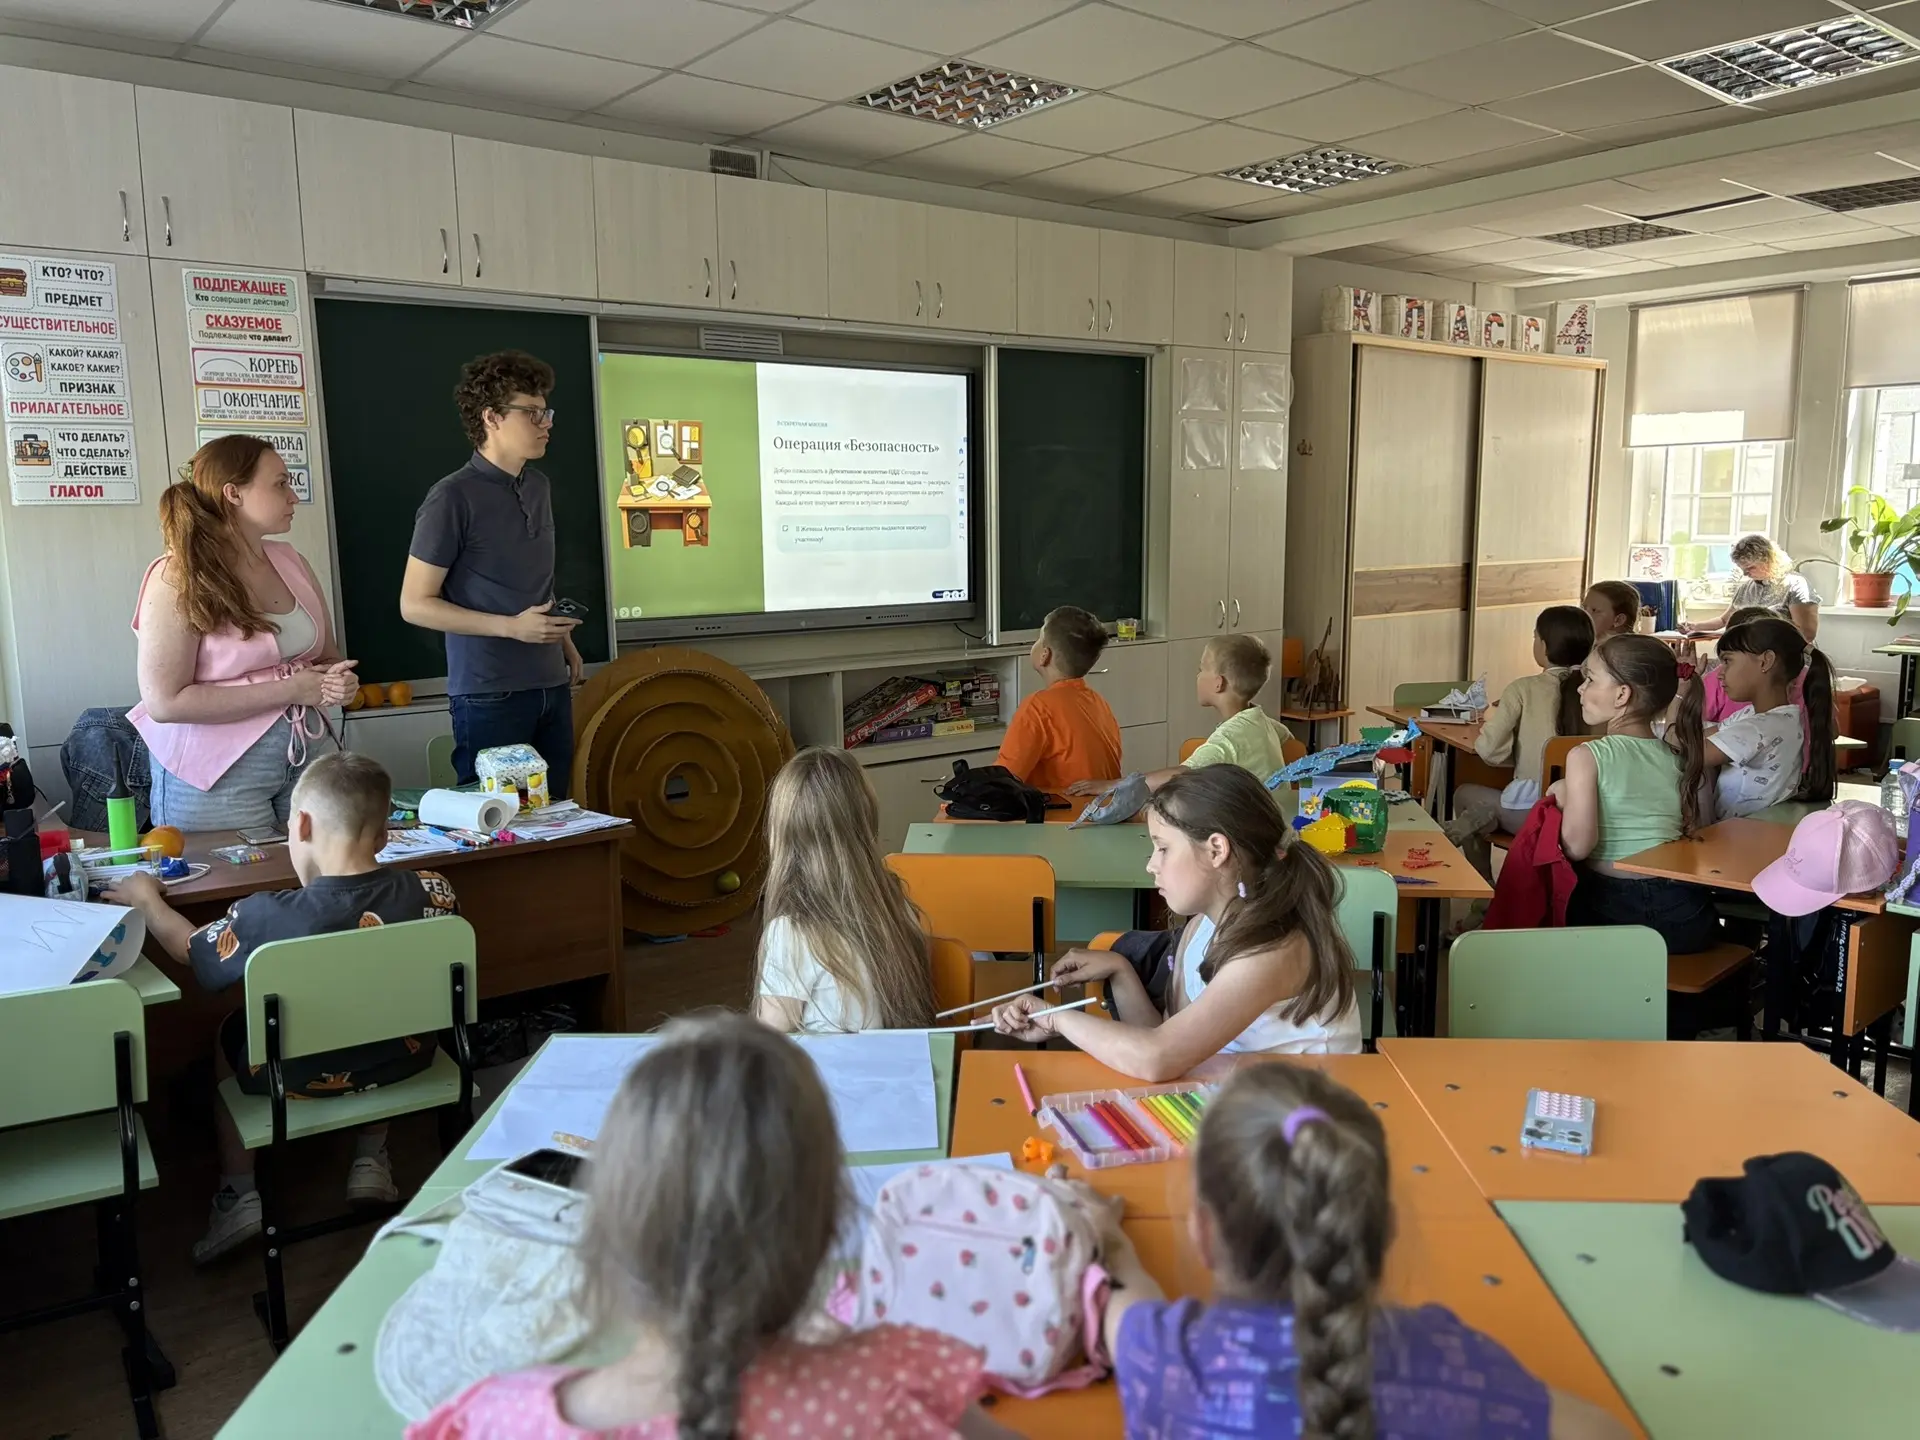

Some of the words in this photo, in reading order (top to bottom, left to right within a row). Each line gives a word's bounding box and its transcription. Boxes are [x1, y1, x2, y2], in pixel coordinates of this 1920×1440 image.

[41, 265, 71, 279] КТО?
[75, 268, 104, 282] ЧТО?
[193, 276, 288, 295] ПОДЛЕЖАЩЕЕ
[45, 292, 103, 307] ПРЕДМЕТ
[195, 293, 209, 302] Кто
[211, 295, 251, 305] совершает
[205, 314, 283, 331] СКАЗУЕМОЕ
[198, 330, 248, 341] Подлежащее
[248, 333, 262, 341] что
[263, 334, 293, 343] делает?
[49, 346, 83, 358] КАКОЙ?
[86, 350, 119, 360] КАКАЯ?
[50, 362, 85, 373] КАКОЕ?
[87, 364, 120, 374] КАКИЕ?
[249, 357, 298, 374] КОРЕНЬ
[60, 382, 116, 394] ПРИЗНАК
[10, 401, 124, 416] ПРИЛАГАТЕЛЬНОЕ
[223, 392, 301, 410] ОКОНЧАНИЕ
[58, 432, 79, 442] ЧТО
[81, 433, 125, 443] ДЕЛАТЬ?
[773, 436, 842, 454] Операция
[843, 438, 940, 453] «Безопасность»
[57, 447, 77, 457] ЧТО
[79, 448, 130, 459] СДЕЛАТЬ?
[64, 462, 127, 477] ДЕЙСТВИЕ
[49, 484, 104, 498] ГЛАГОЛ
